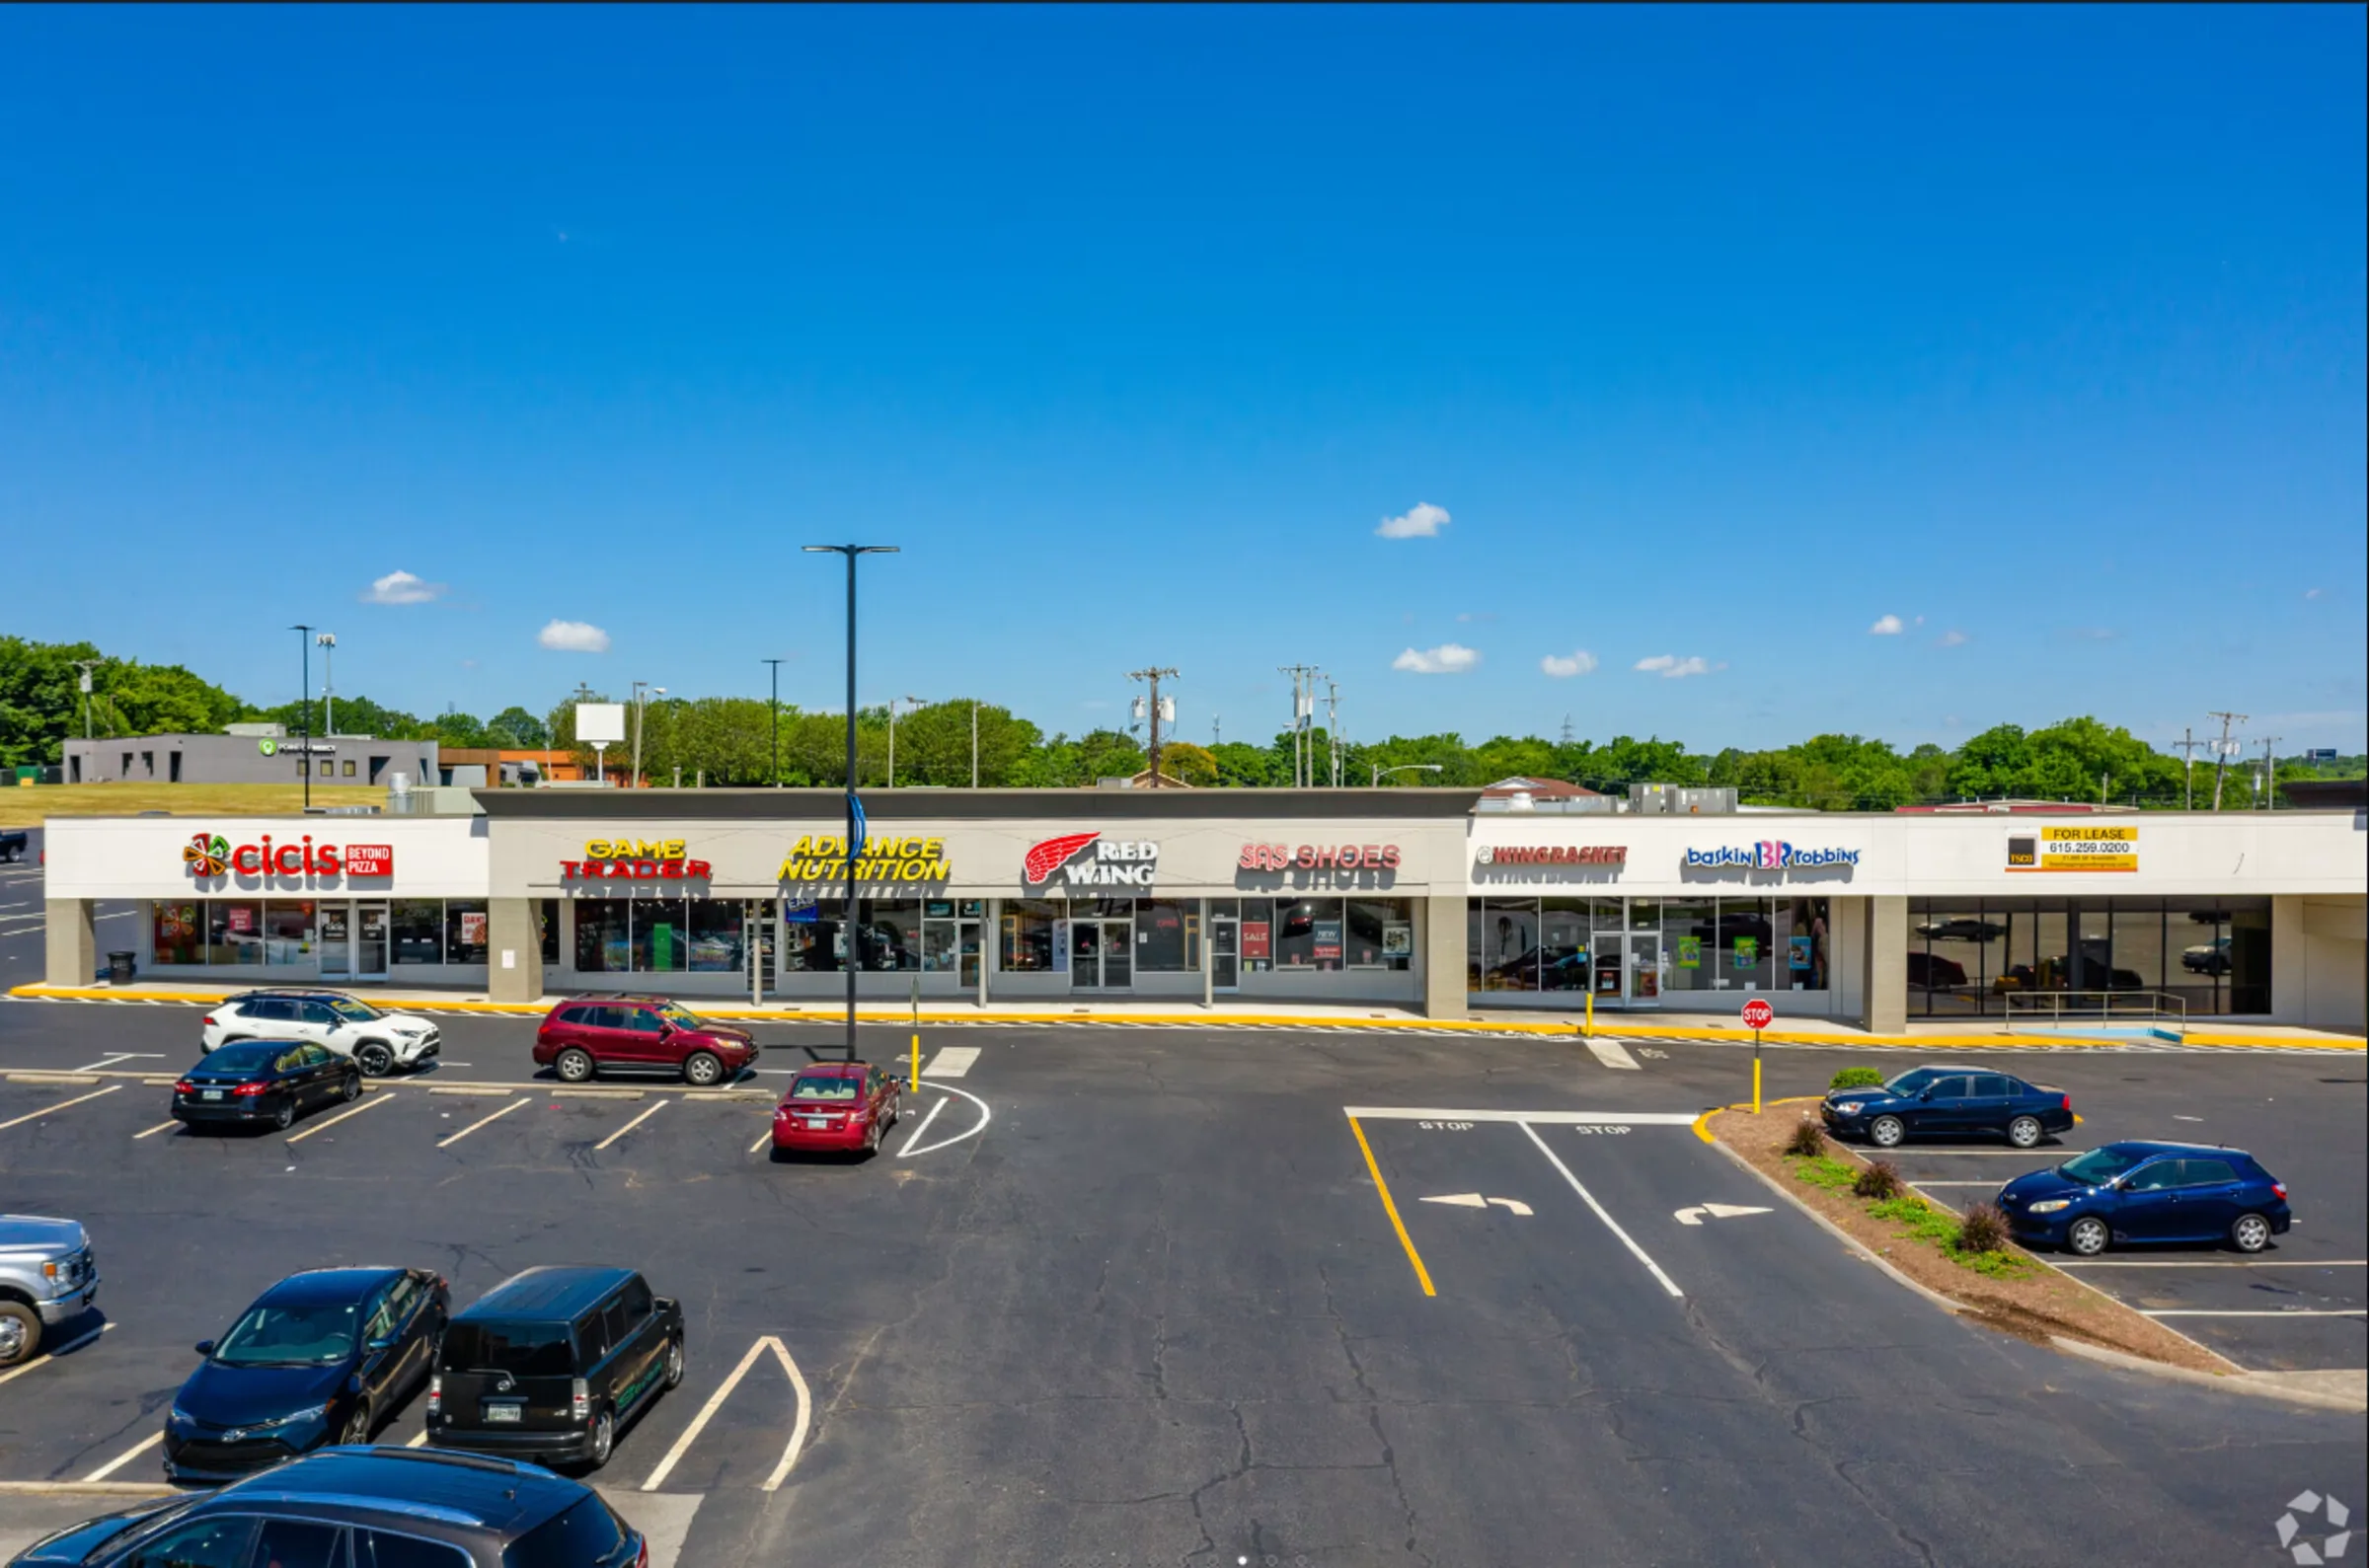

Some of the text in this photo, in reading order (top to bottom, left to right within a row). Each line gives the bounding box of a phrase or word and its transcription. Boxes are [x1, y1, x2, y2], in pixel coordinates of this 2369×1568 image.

[2053, 829, 2125, 840] FOR LEASE
[231, 834, 341, 876] cicis
[347, 847, 390, 859] BEYOND
[584, 839, 686, 859] GAME
[1097, 841, 1159, 860] RED
[1491, 846, 1628, 864] WINGBASKET
[1686, 840, 1861, 869] baskin BR robbins
[2049, 843, 2130, 854] 615.259.0200
[1239, 845, 1402, 871] SAS SHOES
[347, 860, 379, 873] PIZZA
[560, 859, 712, 880] TRADER
[777, 859, 952, 881] NUTRITION
[1064, 864, 1155, 885] WING
[1243, 933, 1267, 941] SALE
[1317, 930, 1337, 938] NEW
[1744, 1008, 1770, 1020] STOP
[1418, 1121, 1474, 1131] STOP
[1575, 1125, 1632, 1135] STOP
